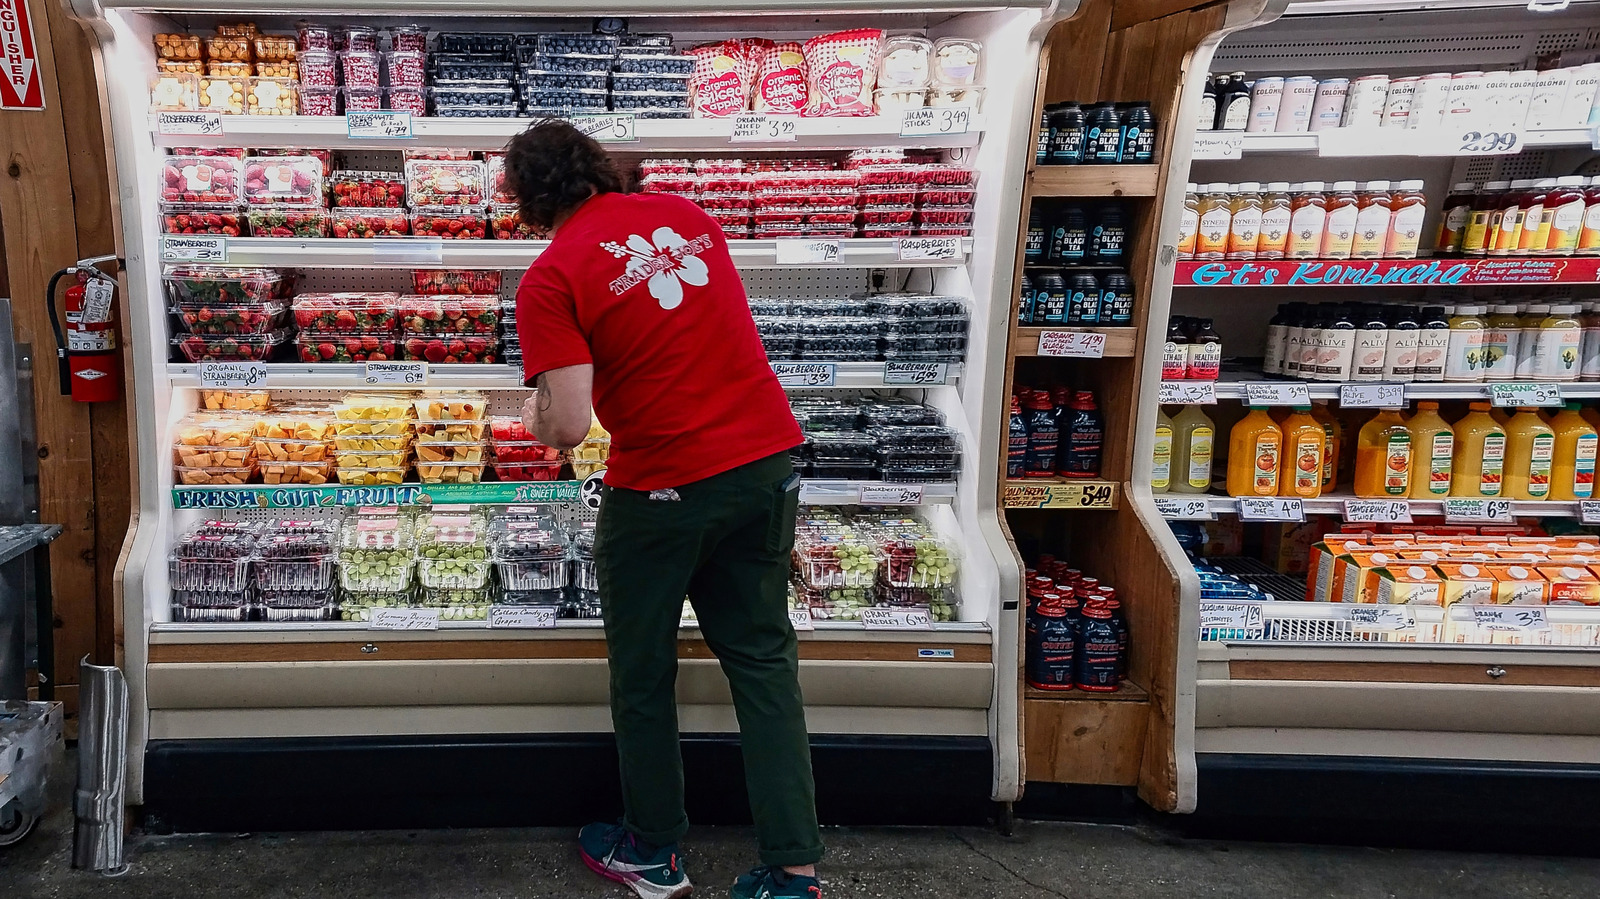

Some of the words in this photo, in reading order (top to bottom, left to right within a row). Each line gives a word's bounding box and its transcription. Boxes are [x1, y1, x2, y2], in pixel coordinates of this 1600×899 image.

[704, 78, 738, 92] organic
[767, 74, 801, 87] organic
[905, 111, 934, 120] JICAMA
[573, 117, 596, 125] JUMBO
[905, 120, 931, 128] STICKS
[164, 239, 218, 249] STRAWBERRIES
[900, 238, 957, 250] RASPBERRIES
[608, 254, 676, 296] TRADER
[674, 233, 714, 260] JOE'S
[1192, 263, 1279, 285] Gt's
[1288, 262, 1471, 285] Kombucha
[368, 363, 421, 371] STRAWBERRIES
[1493, 384, 1538, 392] ORGANIC
[521, 487, 527, 499] A
[530, 487, 553, 498] SWEET
[1024, 486, 1047, 496] BREW
[176, 490, 258, 508] FRESH
[272, 489, 322, 507] CUT
[335, 486, 422, 507] FRUIT
[1347, 506, 1387, 514] TANGERINE
[865, 610, 893, 618] GRAPE
